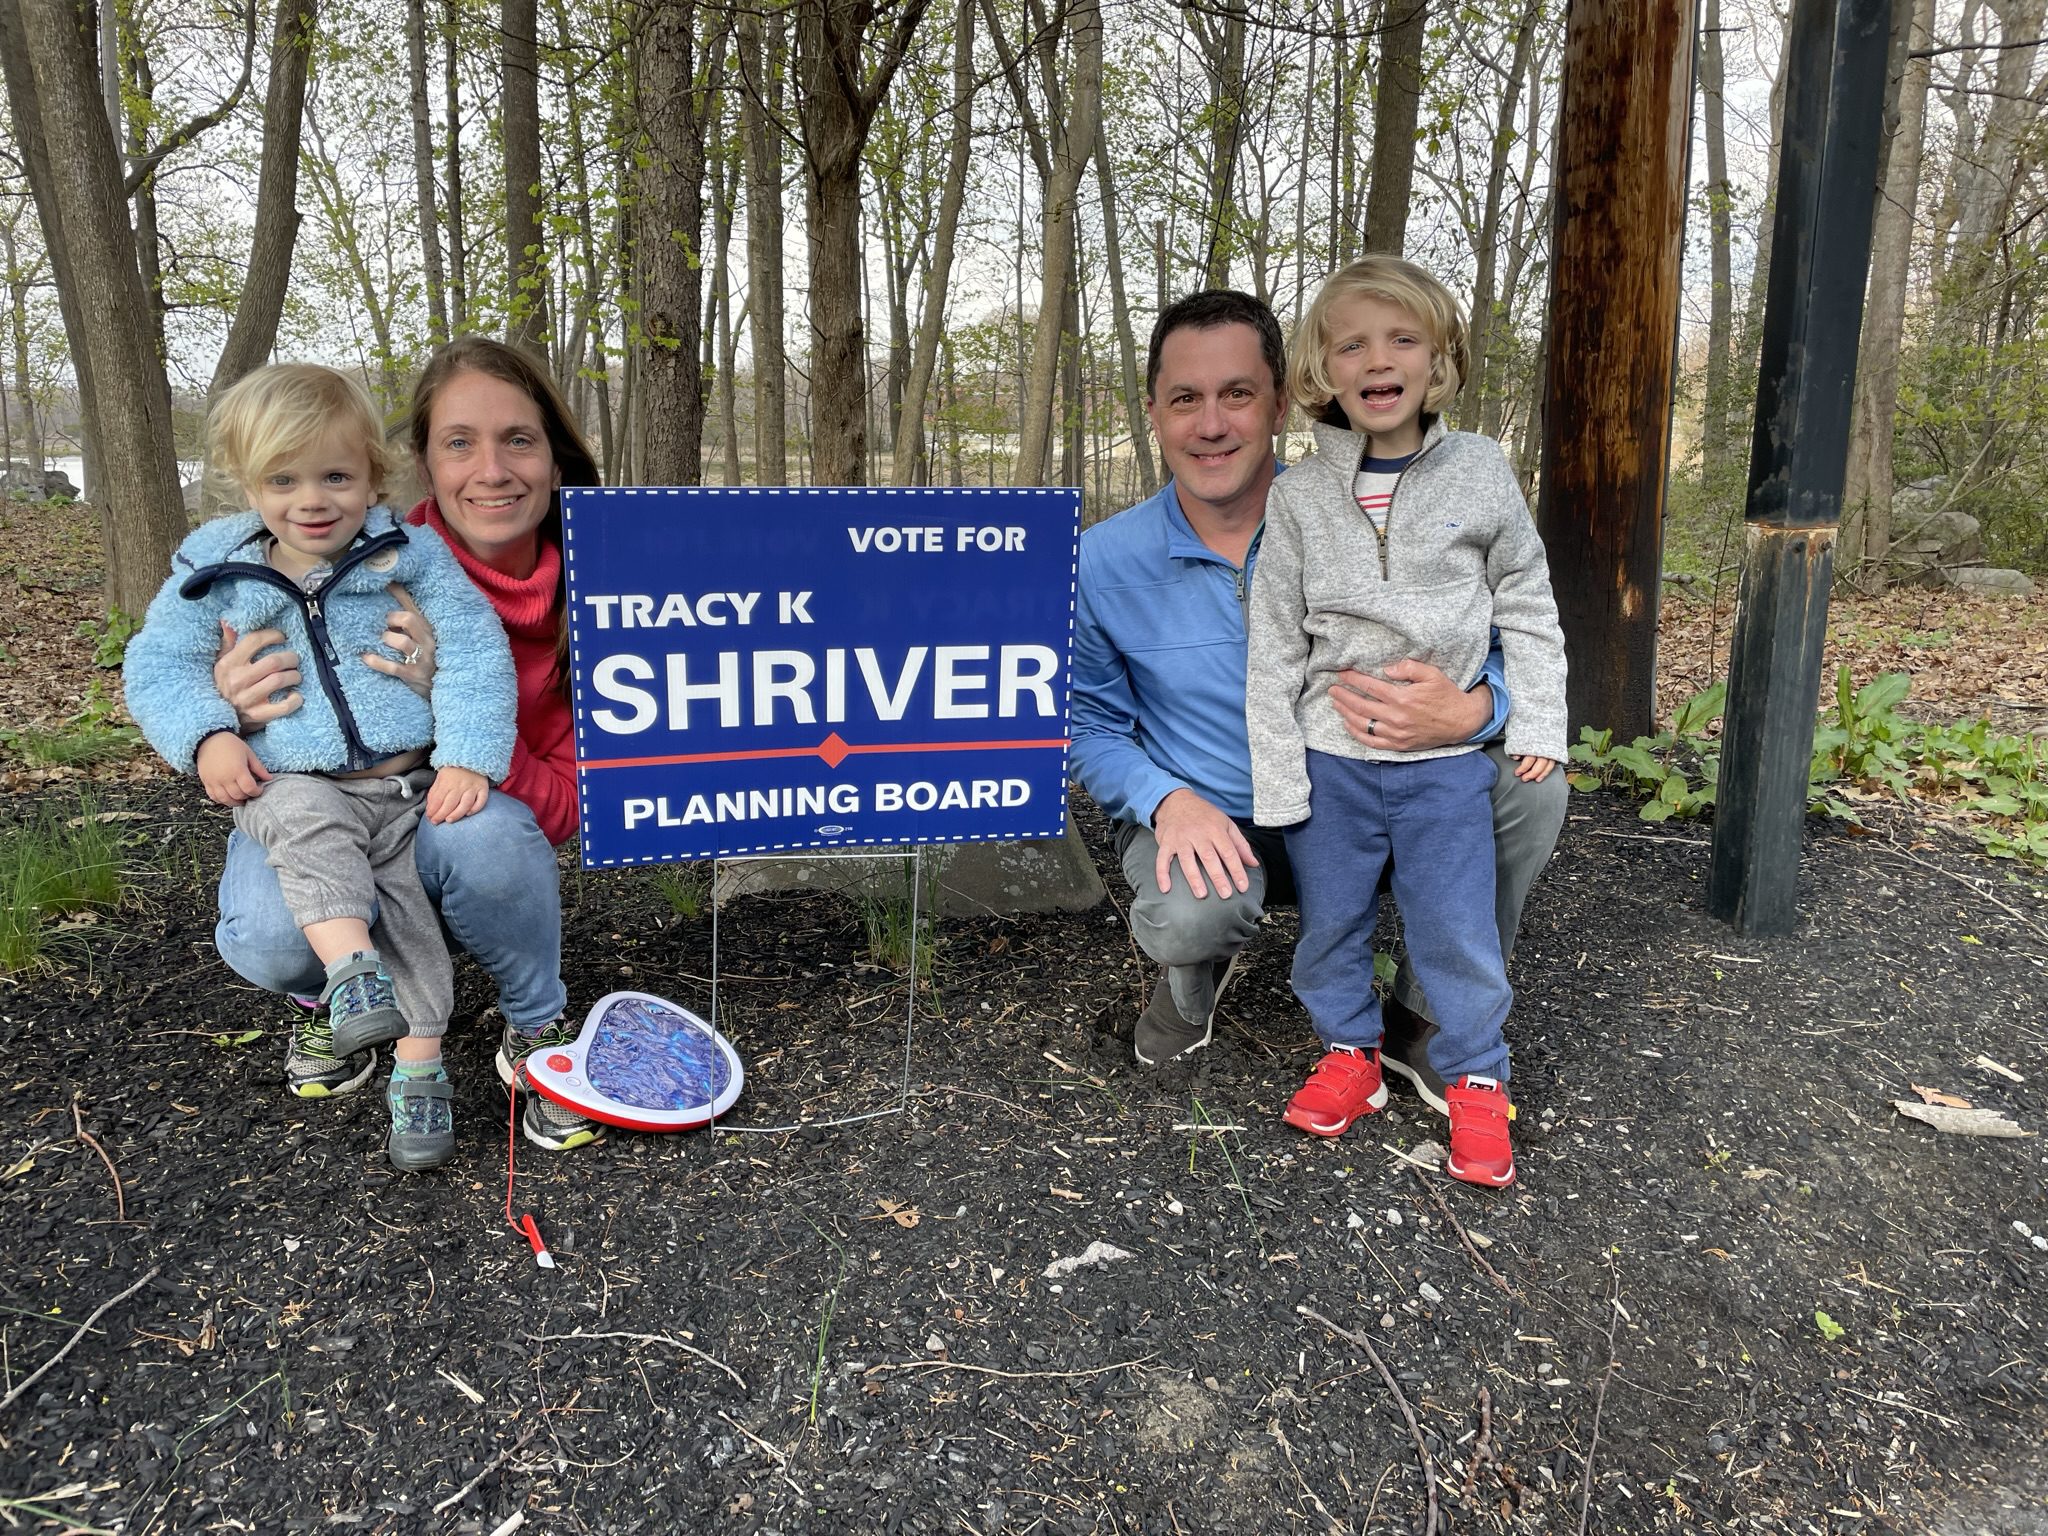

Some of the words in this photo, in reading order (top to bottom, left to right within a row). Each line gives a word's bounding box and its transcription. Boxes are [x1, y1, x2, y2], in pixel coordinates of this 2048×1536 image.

[848, 526, 944, 553] VOTE
[957, 526, 1026, 552] FOR
[584, 592, 762, 629] TRACY
[778, 591, 815, 624] K
[591, 644, 1059, 735] SHRIVER
[623, 783, 860, 830] PLANNING
[875, 778, 1031, 812] BOARD
